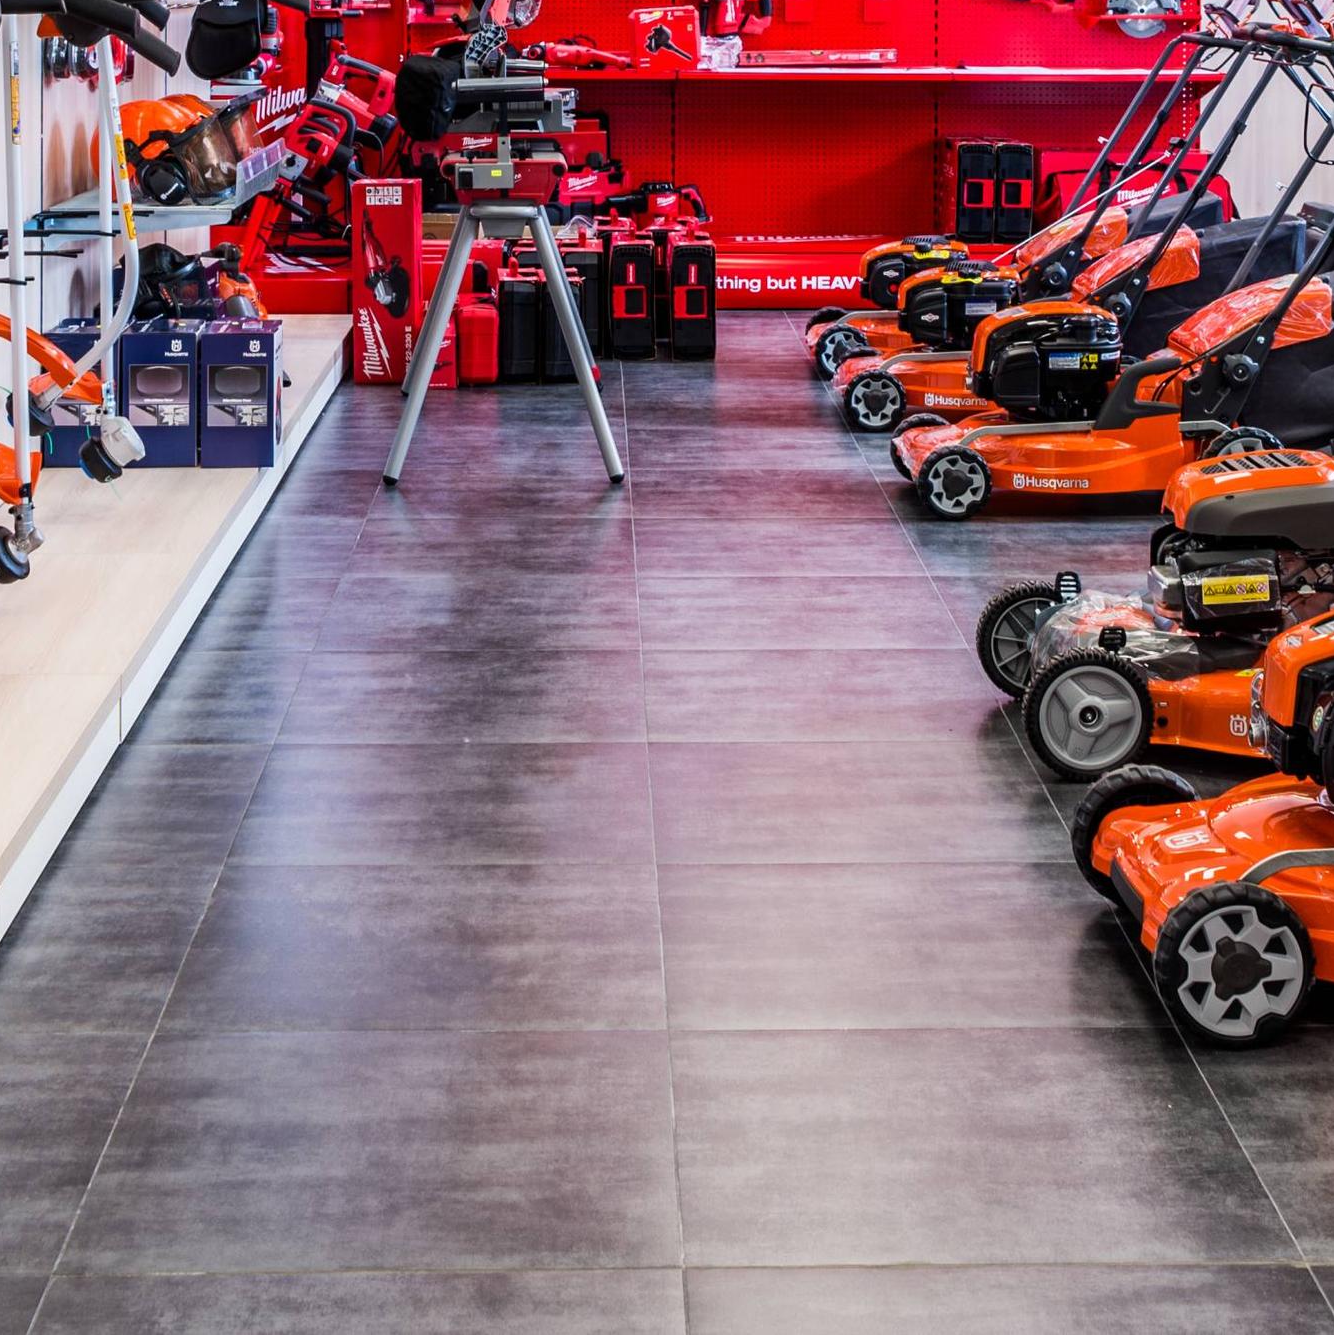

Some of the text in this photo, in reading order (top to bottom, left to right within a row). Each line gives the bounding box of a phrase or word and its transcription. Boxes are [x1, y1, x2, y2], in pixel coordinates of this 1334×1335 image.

[715, 275, 761, 293] thing
[767, 275, 797, 289] but
[357, 308, 385, 378] Milwaukee
[935, 393, 988, 407] Husqvarna
[1025, 474, 1089, 491] Husqvarna
